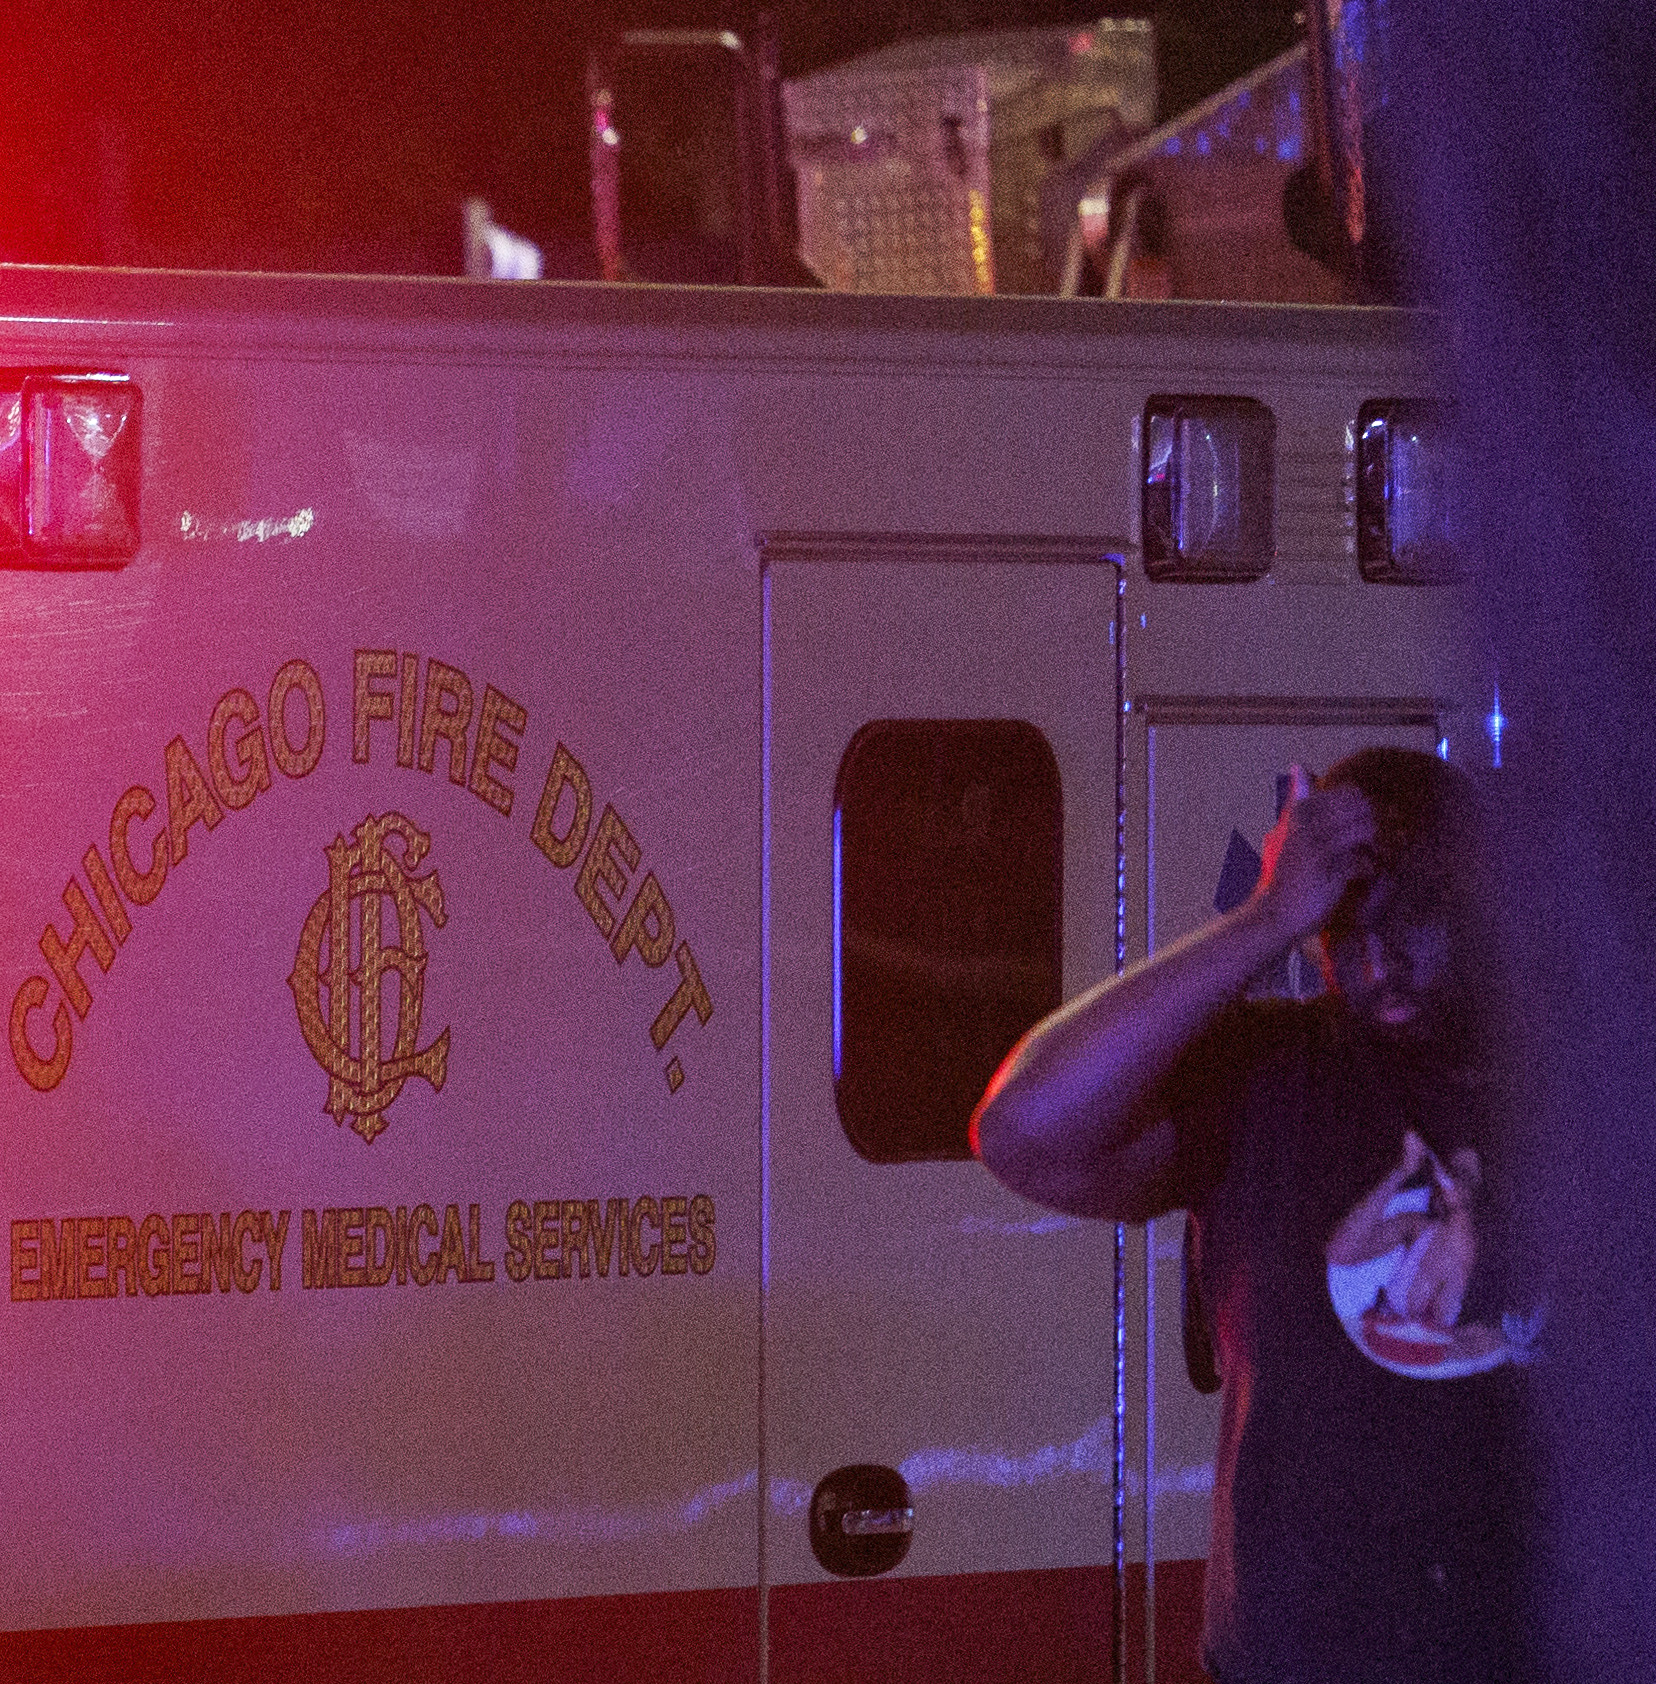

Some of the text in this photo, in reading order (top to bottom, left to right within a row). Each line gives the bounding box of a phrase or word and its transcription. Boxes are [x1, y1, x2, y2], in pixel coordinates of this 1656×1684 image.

[7, 648, 714, 1095] CHICAGO FIRE DEPT.
[10, 1194, 717, 1302] EMERGENCY MEDICAL SERVICES
